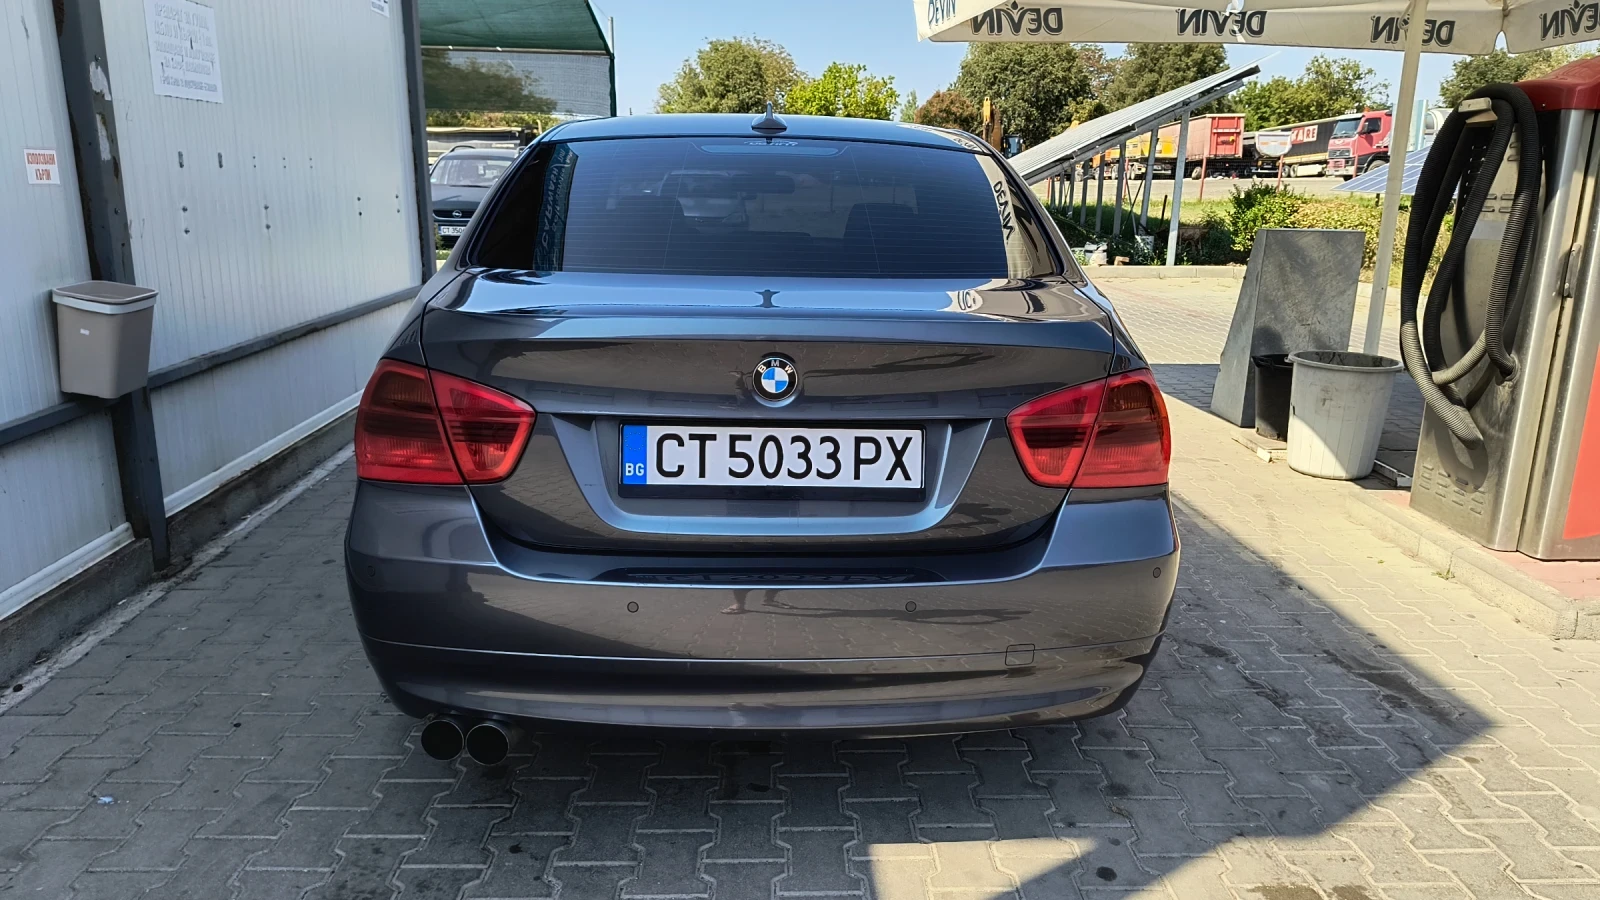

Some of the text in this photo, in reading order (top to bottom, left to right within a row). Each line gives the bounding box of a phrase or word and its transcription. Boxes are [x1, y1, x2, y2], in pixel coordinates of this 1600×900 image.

[757, 359, 794, 374] BMW
[656, 433, 913, 481] CT 5033 PX
[625, 462, 645, 477] BG
